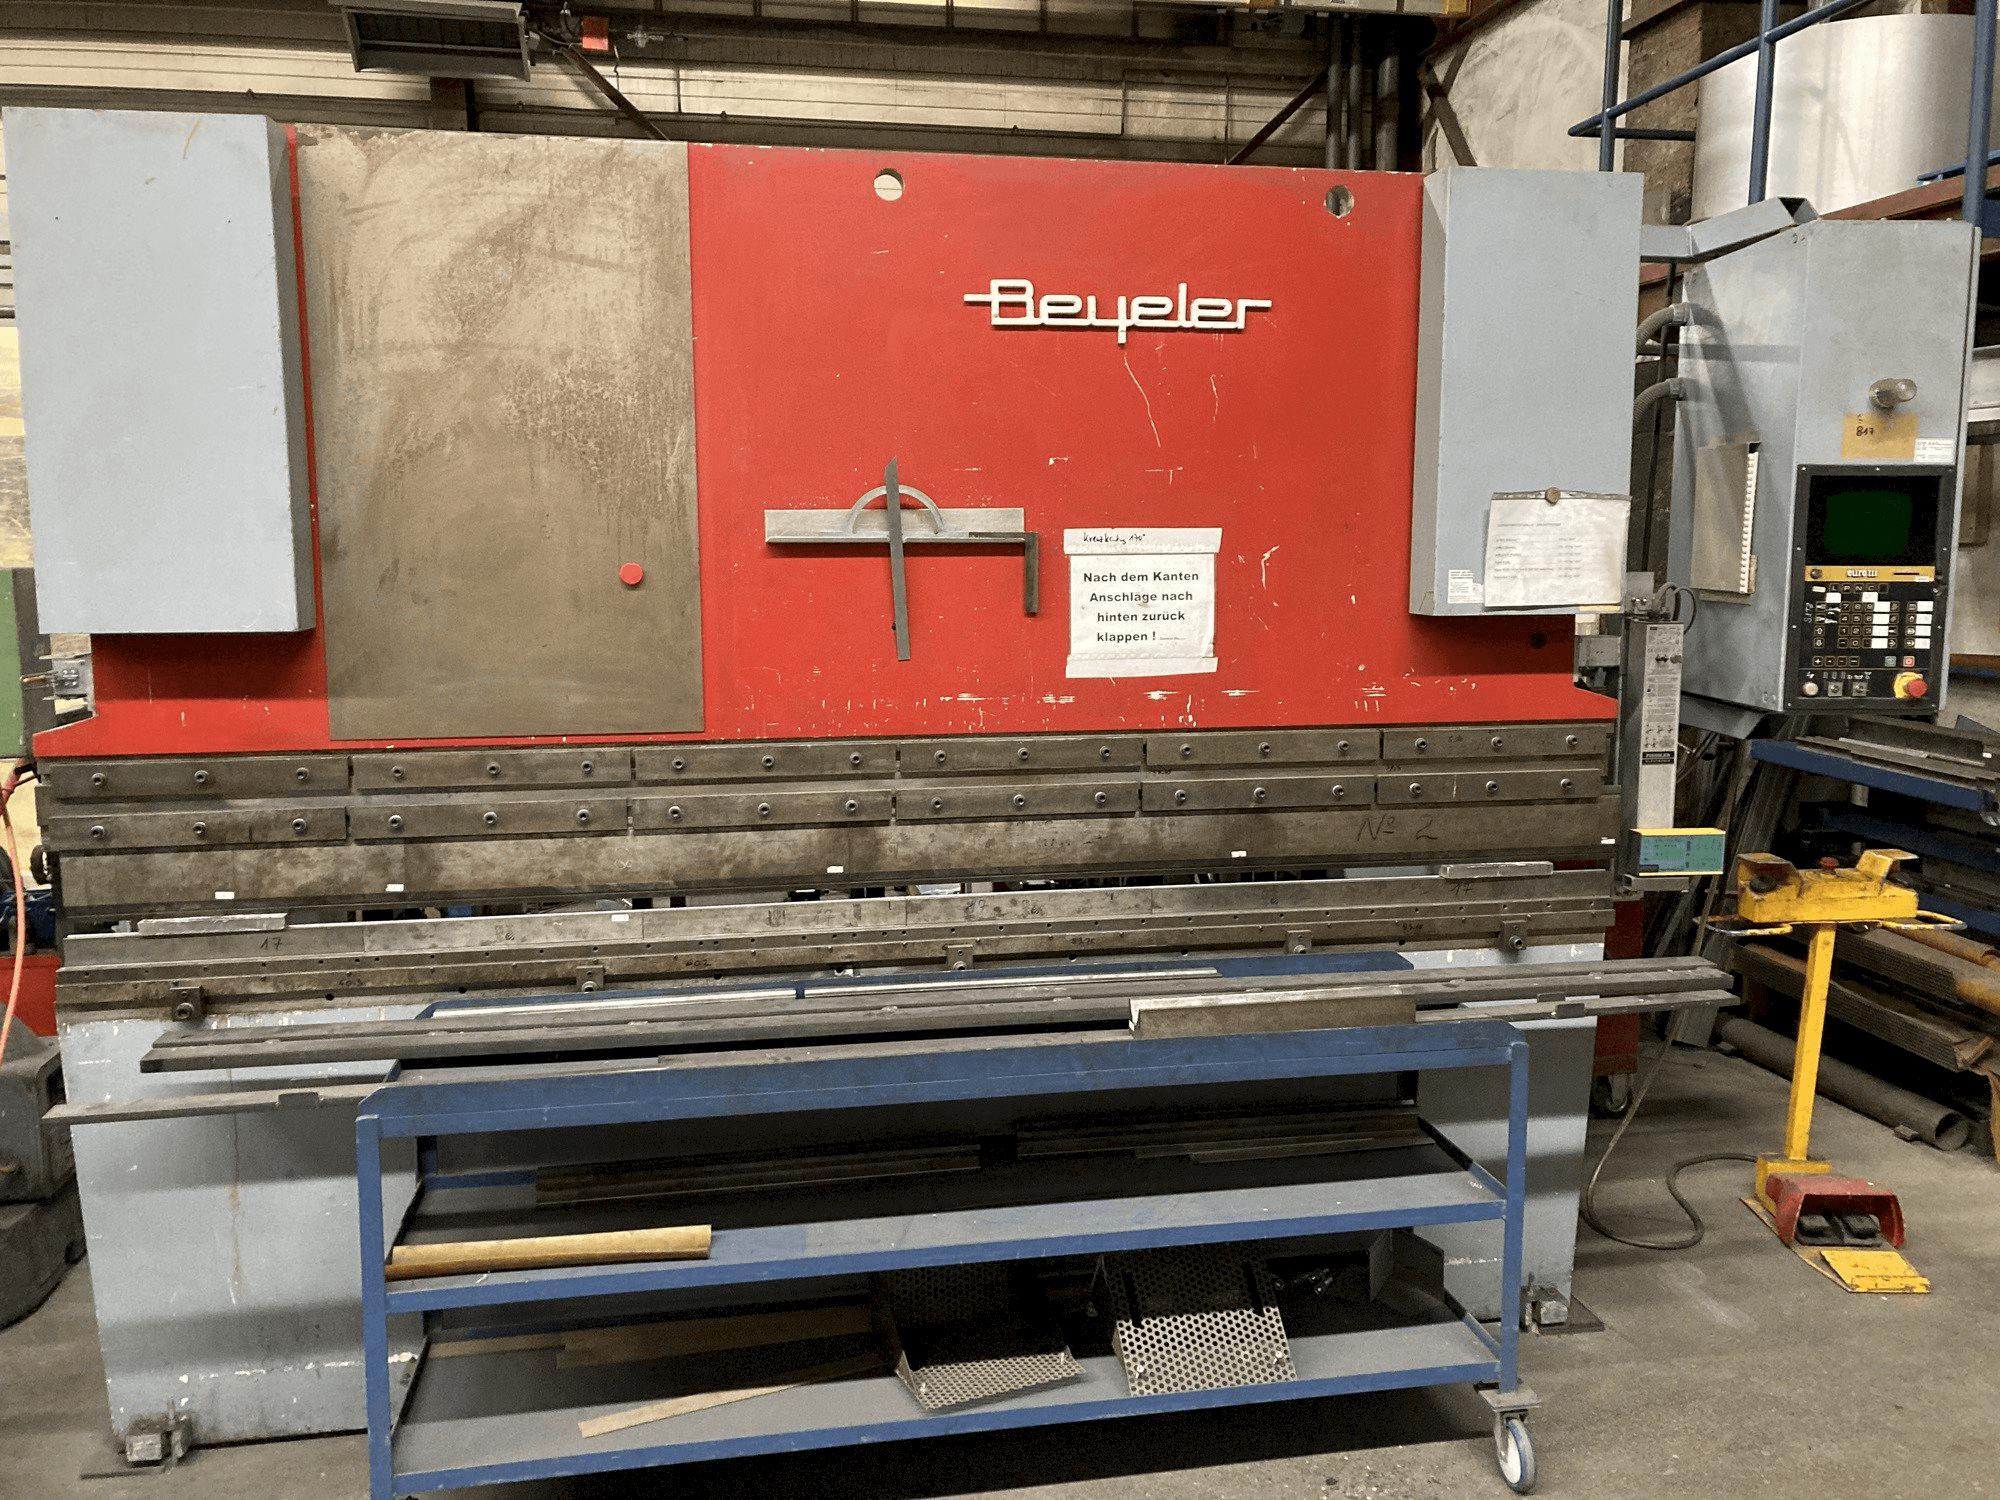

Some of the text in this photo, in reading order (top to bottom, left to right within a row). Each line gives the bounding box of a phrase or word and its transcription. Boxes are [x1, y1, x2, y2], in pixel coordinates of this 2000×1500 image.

[963, 278, 1273, 344] Beyeler
[1083, 571, 1199, 582] Nach dem Kanten
[1089, 590, 1193, 604] Anschläge nach
[1097, 611, 1186, 622] hinten zurück
[1097, 632, 1148, 643] klappen
[1152, 631, 1156, 641] !
[260, 936, 281, 950] 17
